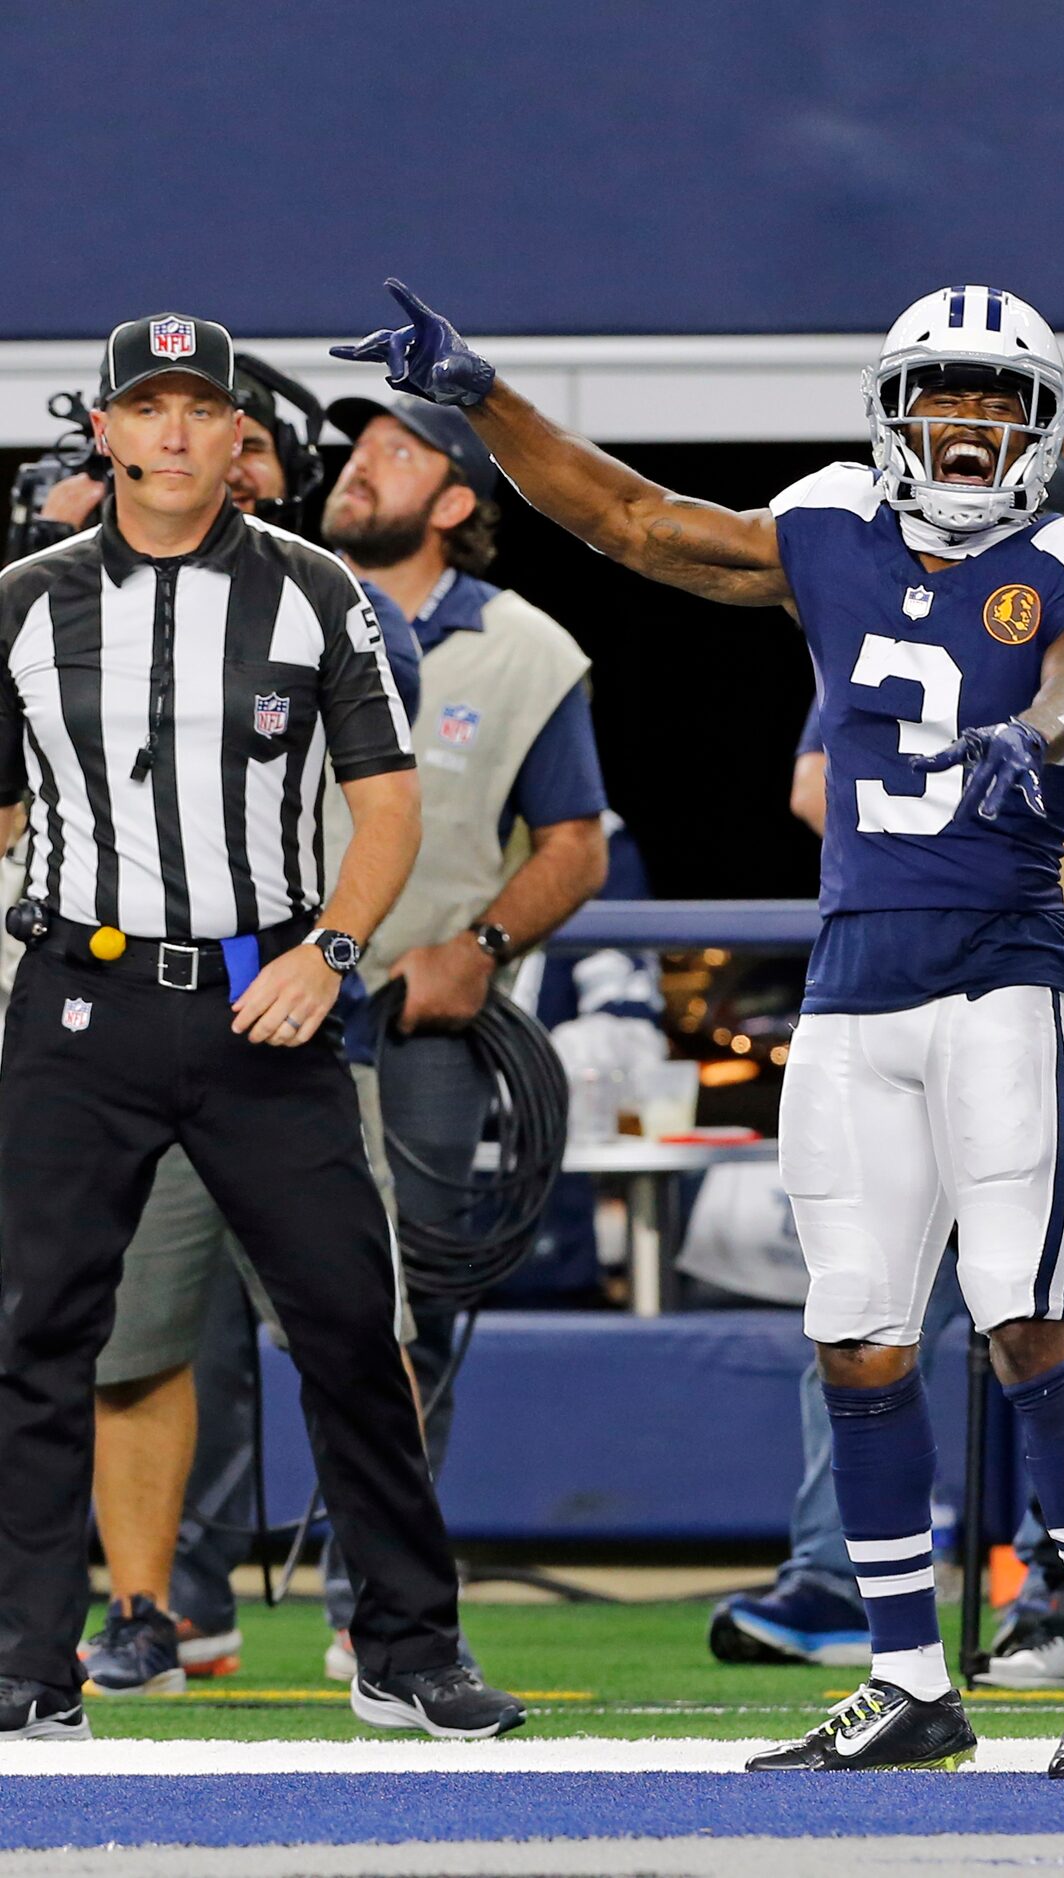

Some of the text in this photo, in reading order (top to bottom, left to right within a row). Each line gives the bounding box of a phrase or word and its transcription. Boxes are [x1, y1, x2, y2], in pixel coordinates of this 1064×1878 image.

[156, 335, 191, 353] NFL
[361, 607, 381, 644] 5
[258, 711, 287, 733] NFL
[850, 633, 963, 836] 3
[66, 1011, 88, 1027] NFL
